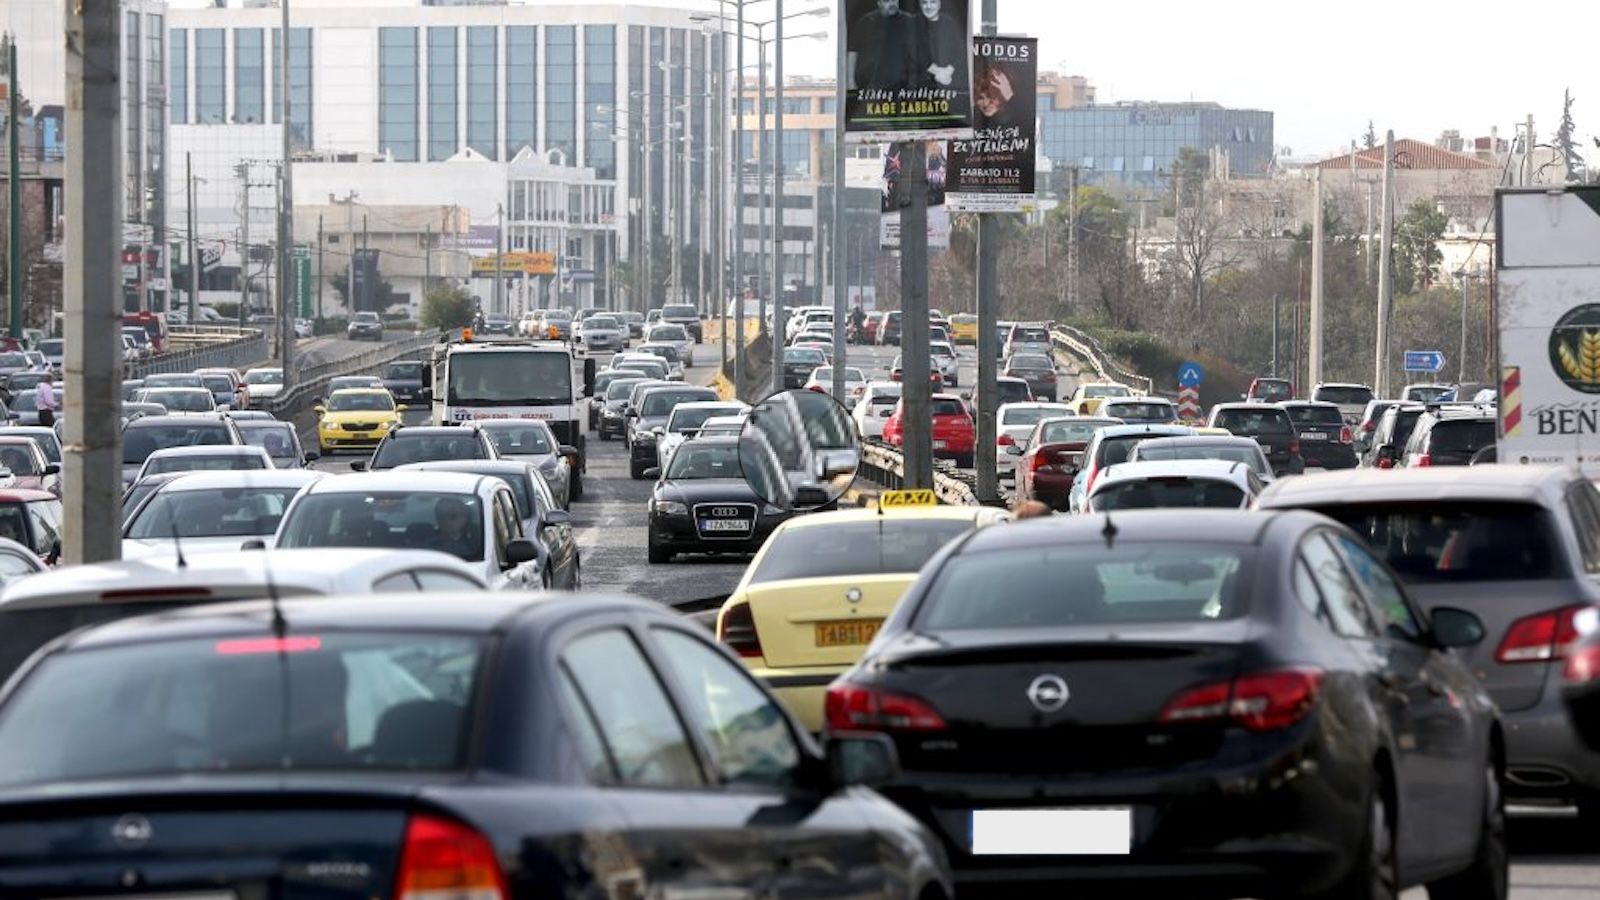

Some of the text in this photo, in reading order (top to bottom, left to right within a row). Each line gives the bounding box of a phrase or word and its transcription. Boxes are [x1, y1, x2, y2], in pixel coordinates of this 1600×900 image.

[866, 100, 949, 114] ΚΑΘΕ ΣΑΒΒΑΤΟ
[960, 167, 1000, 177] ΣΑΒΒΑΤΟ
[884, 491, 931, 505] TAXI
